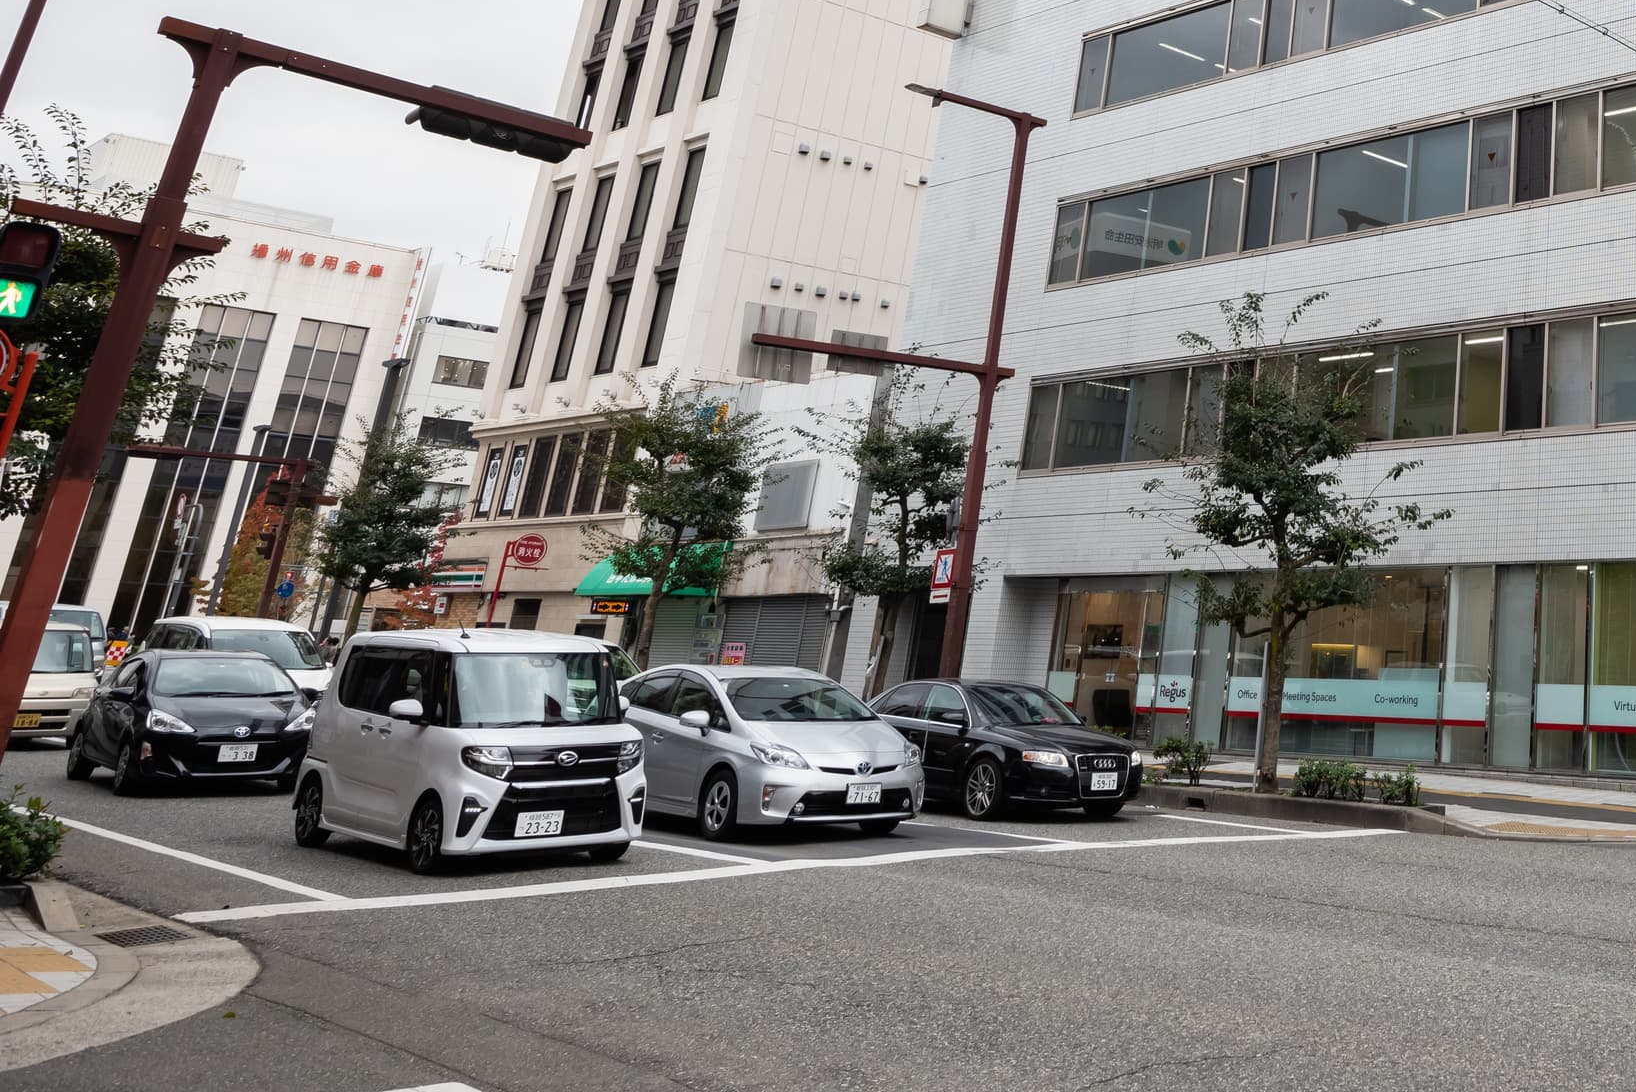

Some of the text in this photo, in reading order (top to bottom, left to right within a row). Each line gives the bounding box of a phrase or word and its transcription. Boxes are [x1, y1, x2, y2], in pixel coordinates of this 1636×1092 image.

[250, 243, 385, 278] 播州信用金庫
[518, 547, 542, 558] 消火栓
[1159, 685, 1186, 702] Regus
[1237, 689, 1258, 699] Office
[1282, 692, 1337, 703] Meeting Spaces
[1374, 693, 1418, 707] Co-working
[1096, 779, 1116, 789] 59-17
[854, 791, 880, 803] 71-67
[525, 820, 560, 835] 23-23
